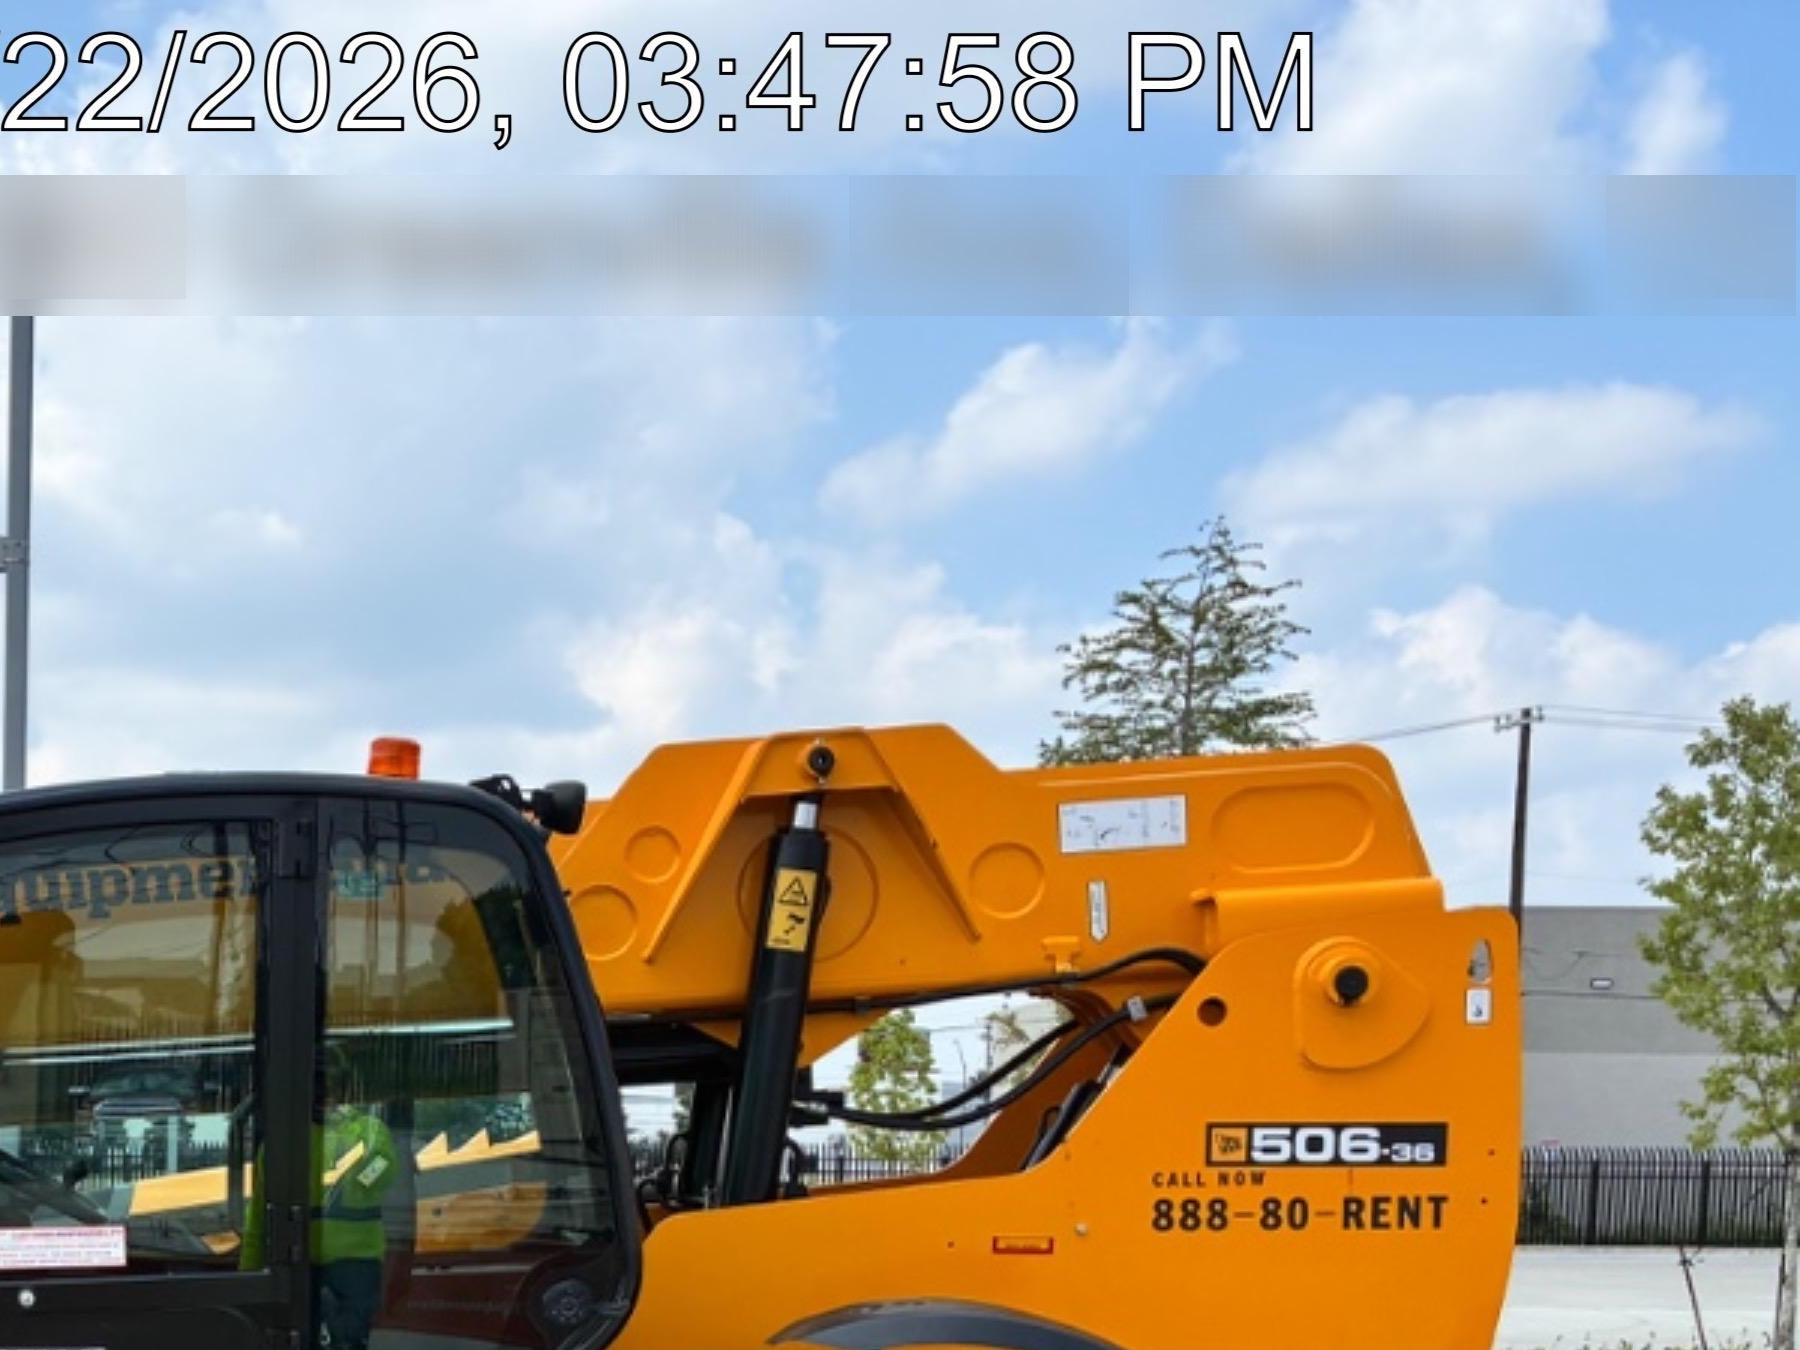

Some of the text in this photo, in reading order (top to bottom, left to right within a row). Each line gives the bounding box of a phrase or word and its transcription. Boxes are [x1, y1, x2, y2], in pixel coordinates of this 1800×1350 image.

[1152, 1170, 1266, 1187] CALL NOW
[1151, 1196, 1449, 1232] 888-80-RENT
